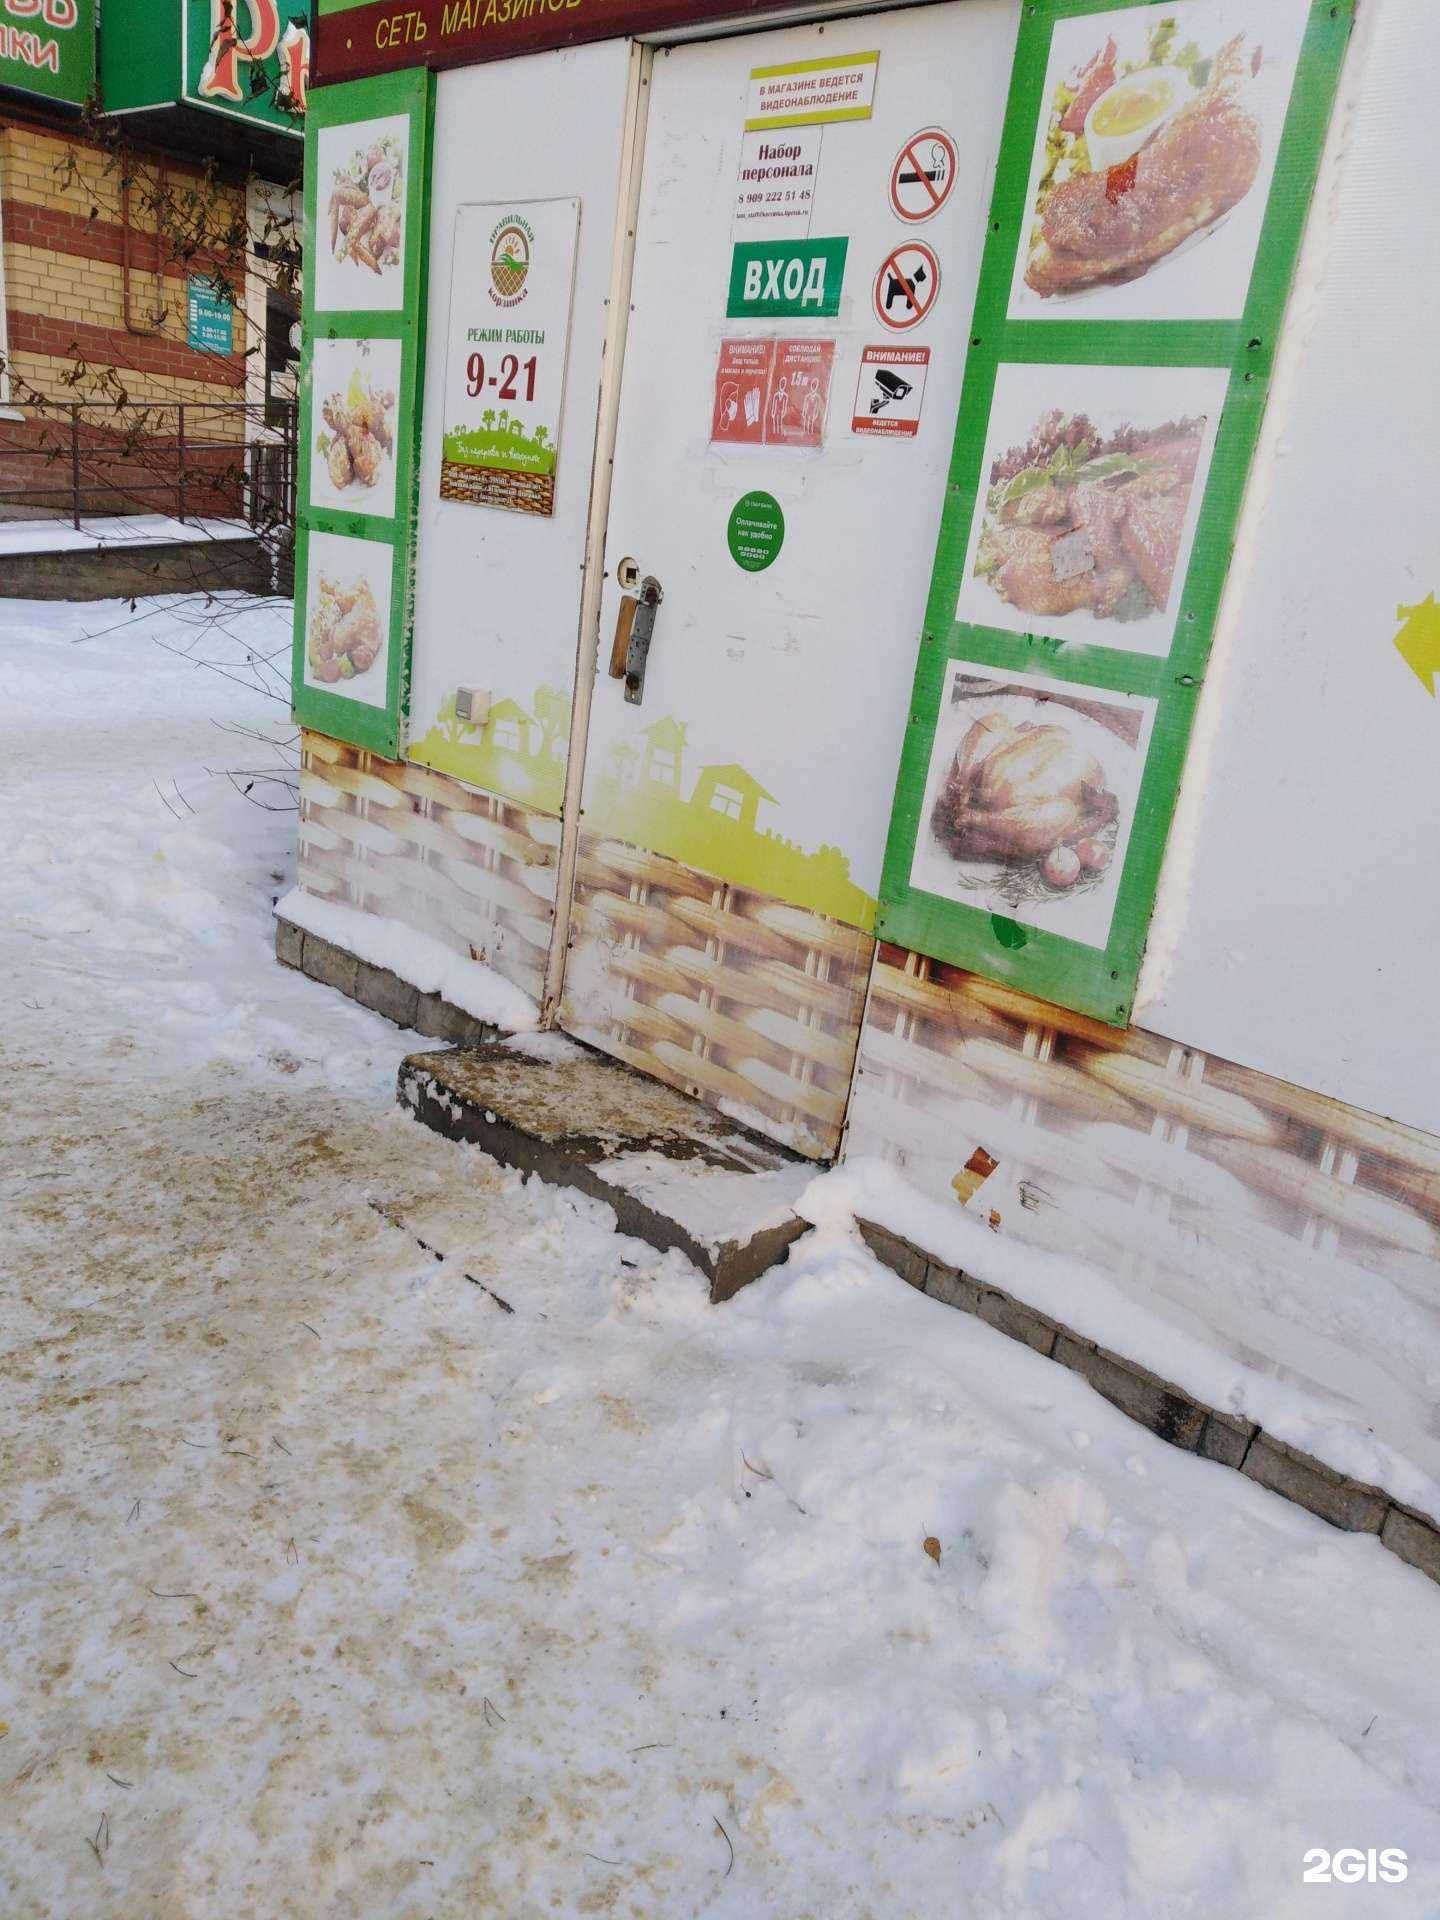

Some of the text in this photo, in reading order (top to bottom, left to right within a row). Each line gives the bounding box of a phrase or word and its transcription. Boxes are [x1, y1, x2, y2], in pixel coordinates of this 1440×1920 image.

[375, 0, 581, 49] СЕТЬ МАГАЗИ
[759, 72, 864, 96] В МАГАЗИНЕ ВЕДЕТСЯ
[760, 90, 858, 112] ВИДЕОНАБЛЮДЕНИЕ
[758, 143, 802, 161] Набор
[742, 163, 813, 183] персонала
[738, 189, 811, 204] 8 909 222 51 48
[743, 257, 827, 307] ВХОД
[467, 328, 545, 344] РЕЖИМ РАБОТЫ
[866, 351, 925, 363] ВНИМАНИЕ!
[466, 352, 537, 402] 9-21
